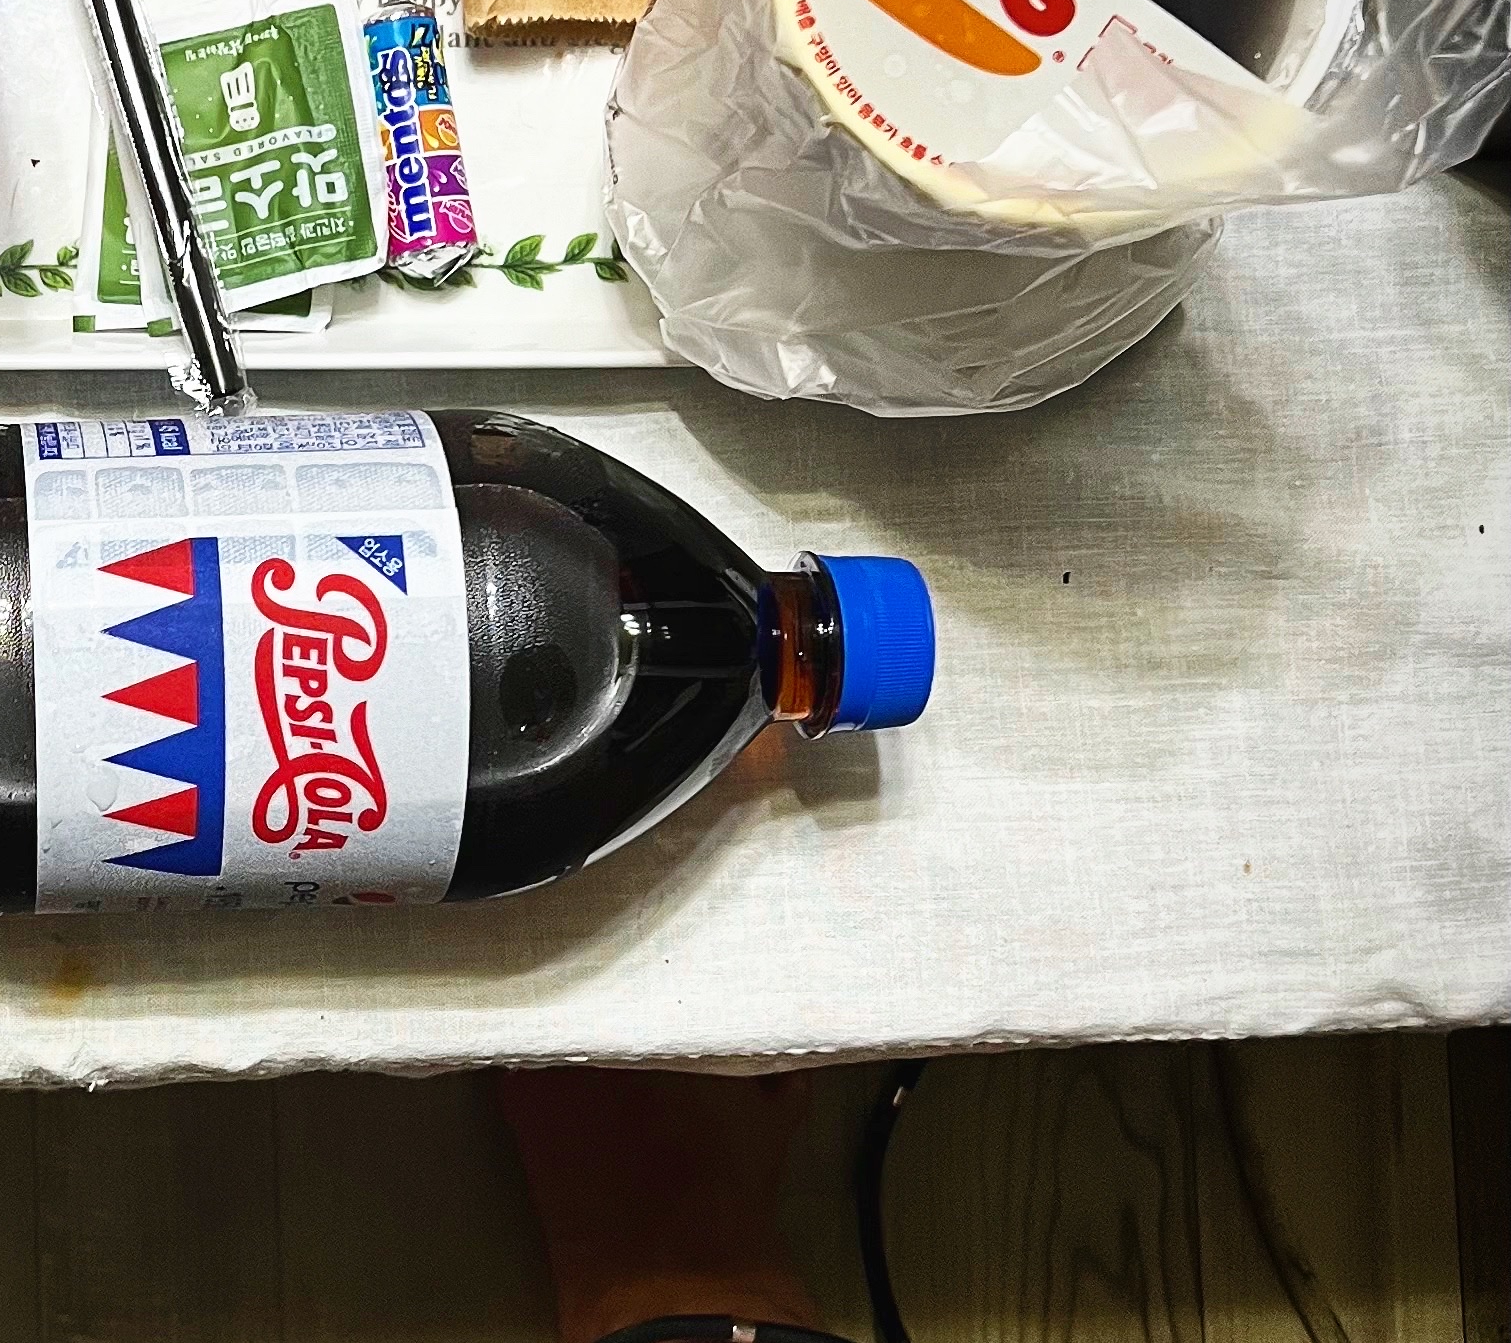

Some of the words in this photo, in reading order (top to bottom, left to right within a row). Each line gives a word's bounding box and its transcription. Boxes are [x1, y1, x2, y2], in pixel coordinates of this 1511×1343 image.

[833, 75, 863, 105] 있어
[233, 128, 324, 157] FLAVORED
[380, 49, 434, 237] mentos
[191, 149, 348, 233] 맛소금
[300, 217, 346, 240] 치킨과
[358, 536, 404, 578] 업소용
